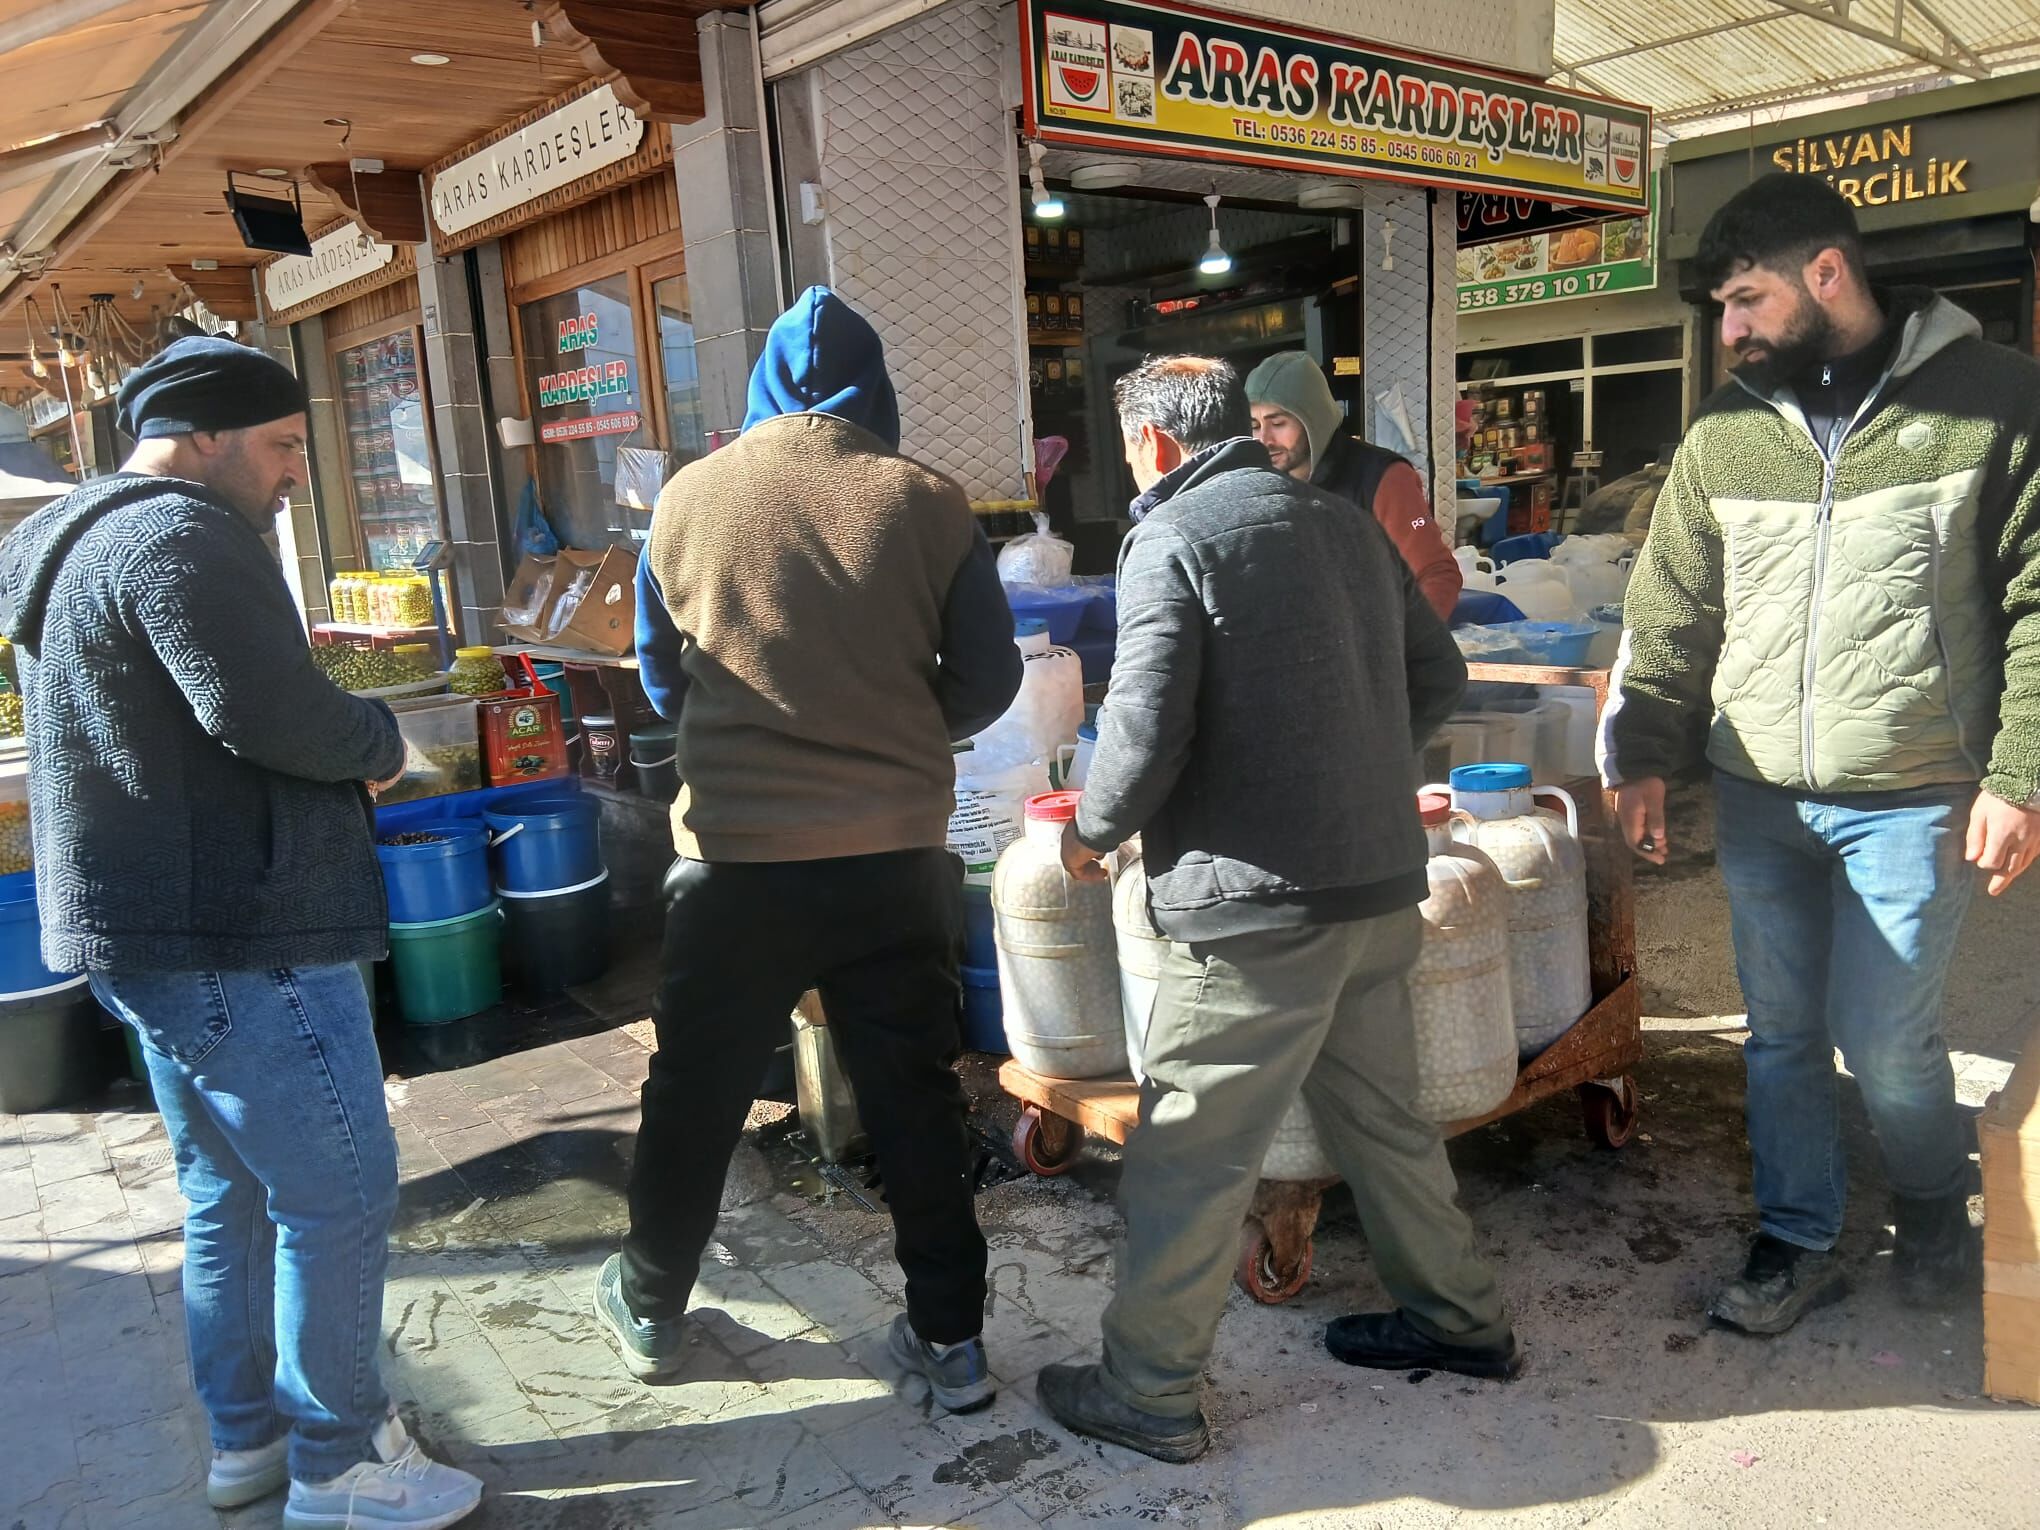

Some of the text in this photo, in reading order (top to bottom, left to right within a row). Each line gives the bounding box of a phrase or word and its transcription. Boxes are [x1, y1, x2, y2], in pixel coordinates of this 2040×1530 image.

[1162, 33, 1581, 165] ARAS KARDEŞLER
[442, 102, 631, 217] ARAS KARDEŞLER
[1232, 118, 1266, 139] TEL:
[1270, 124, 1306, 145] 0536
[1310, 130, 1336, 149] 224
[1340, 134, 1357, 152] 55
[1361, 138, 1376, 155] 85
[1387, 142, 1418, 160] 0545
[1421, 147, 1443, 164] 606
[1446, 152, 1460, 167] 60
[1464, 154, 1478, 169] 21
[1772, 124, 1912, 174] SİLVAN
[1826, 158, 1968, 207] İRCİLİK
[278, 264, 304, 296] ARAS
[1457, 271, 1611, 308] 538 379 10 17
[558, 312, 599, 354] ARAS
[539, 360, 628, 407] KARDEŞLER
[512, 725, 540, 736] ACAR
